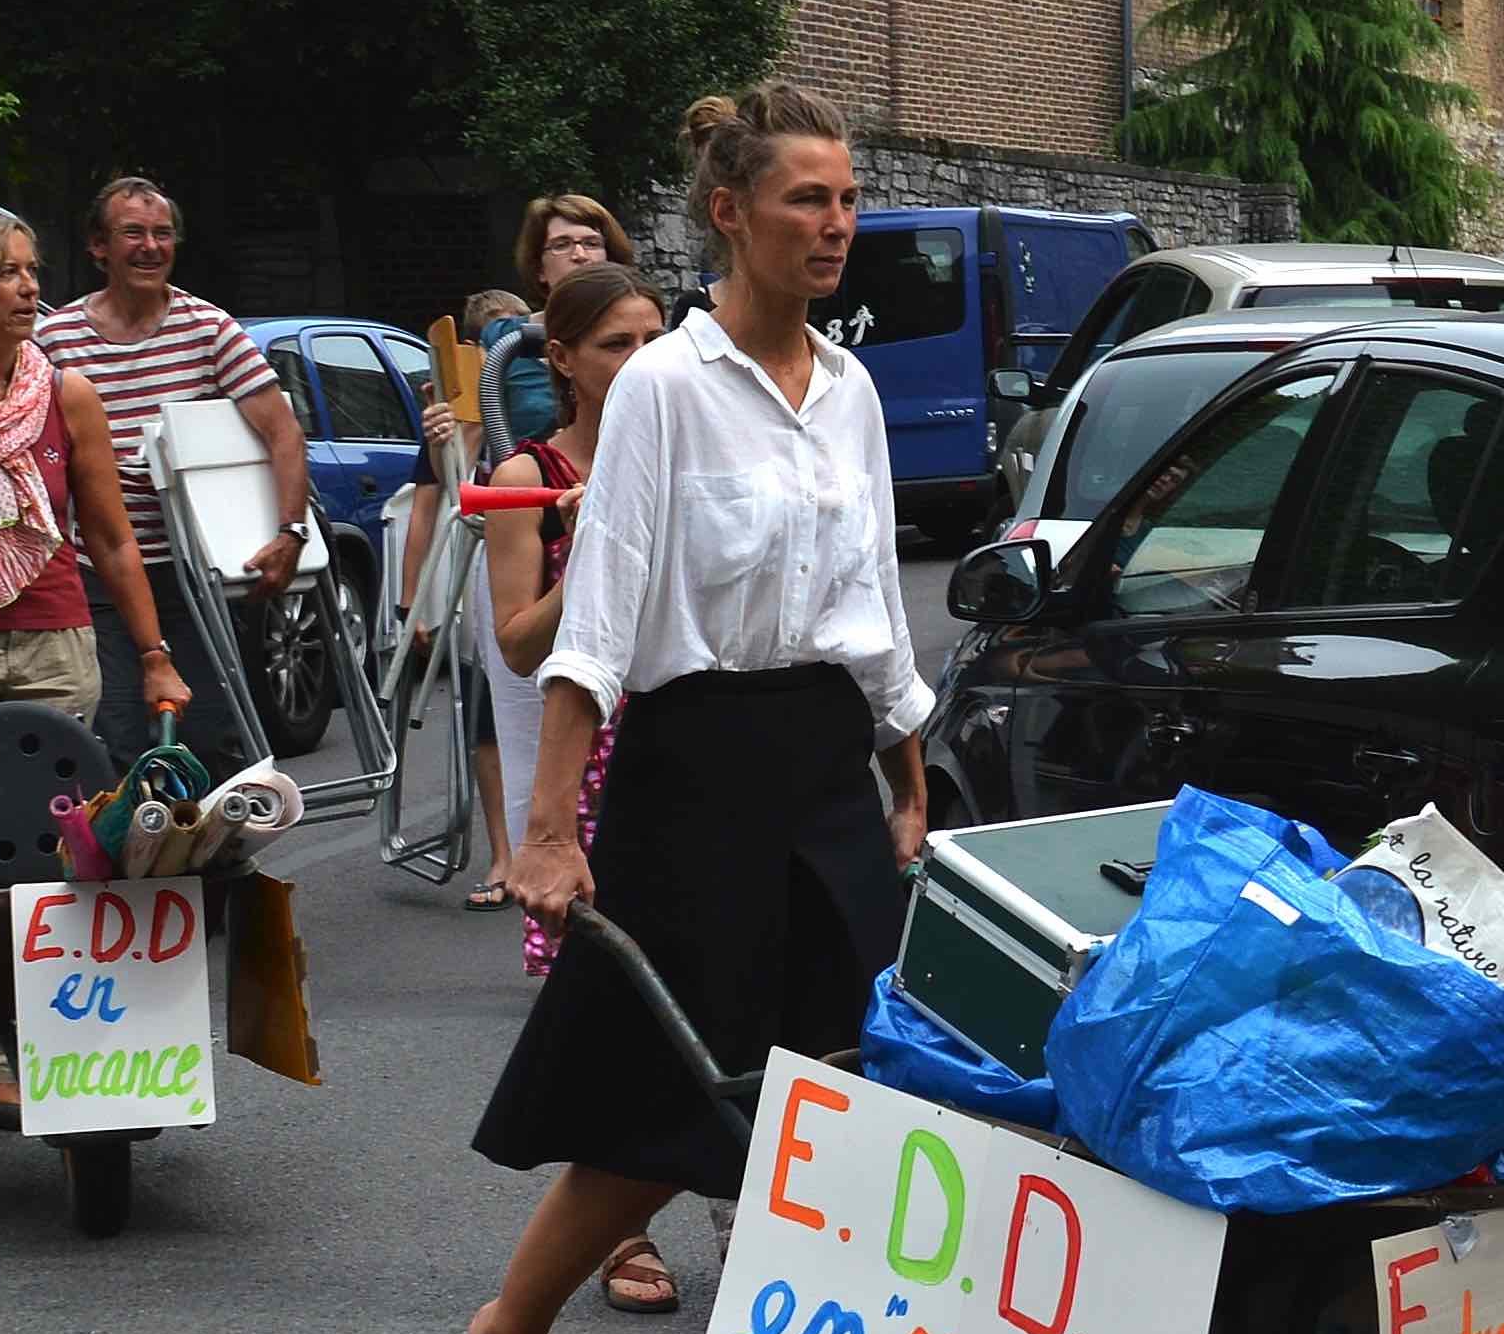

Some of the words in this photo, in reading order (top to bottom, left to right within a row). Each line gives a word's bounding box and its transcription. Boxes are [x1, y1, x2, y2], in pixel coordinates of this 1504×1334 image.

[1408, 851, 1435, 889] la
[1433, 895, 1499, 980] nature
[49, 972, 128, 1024] en
